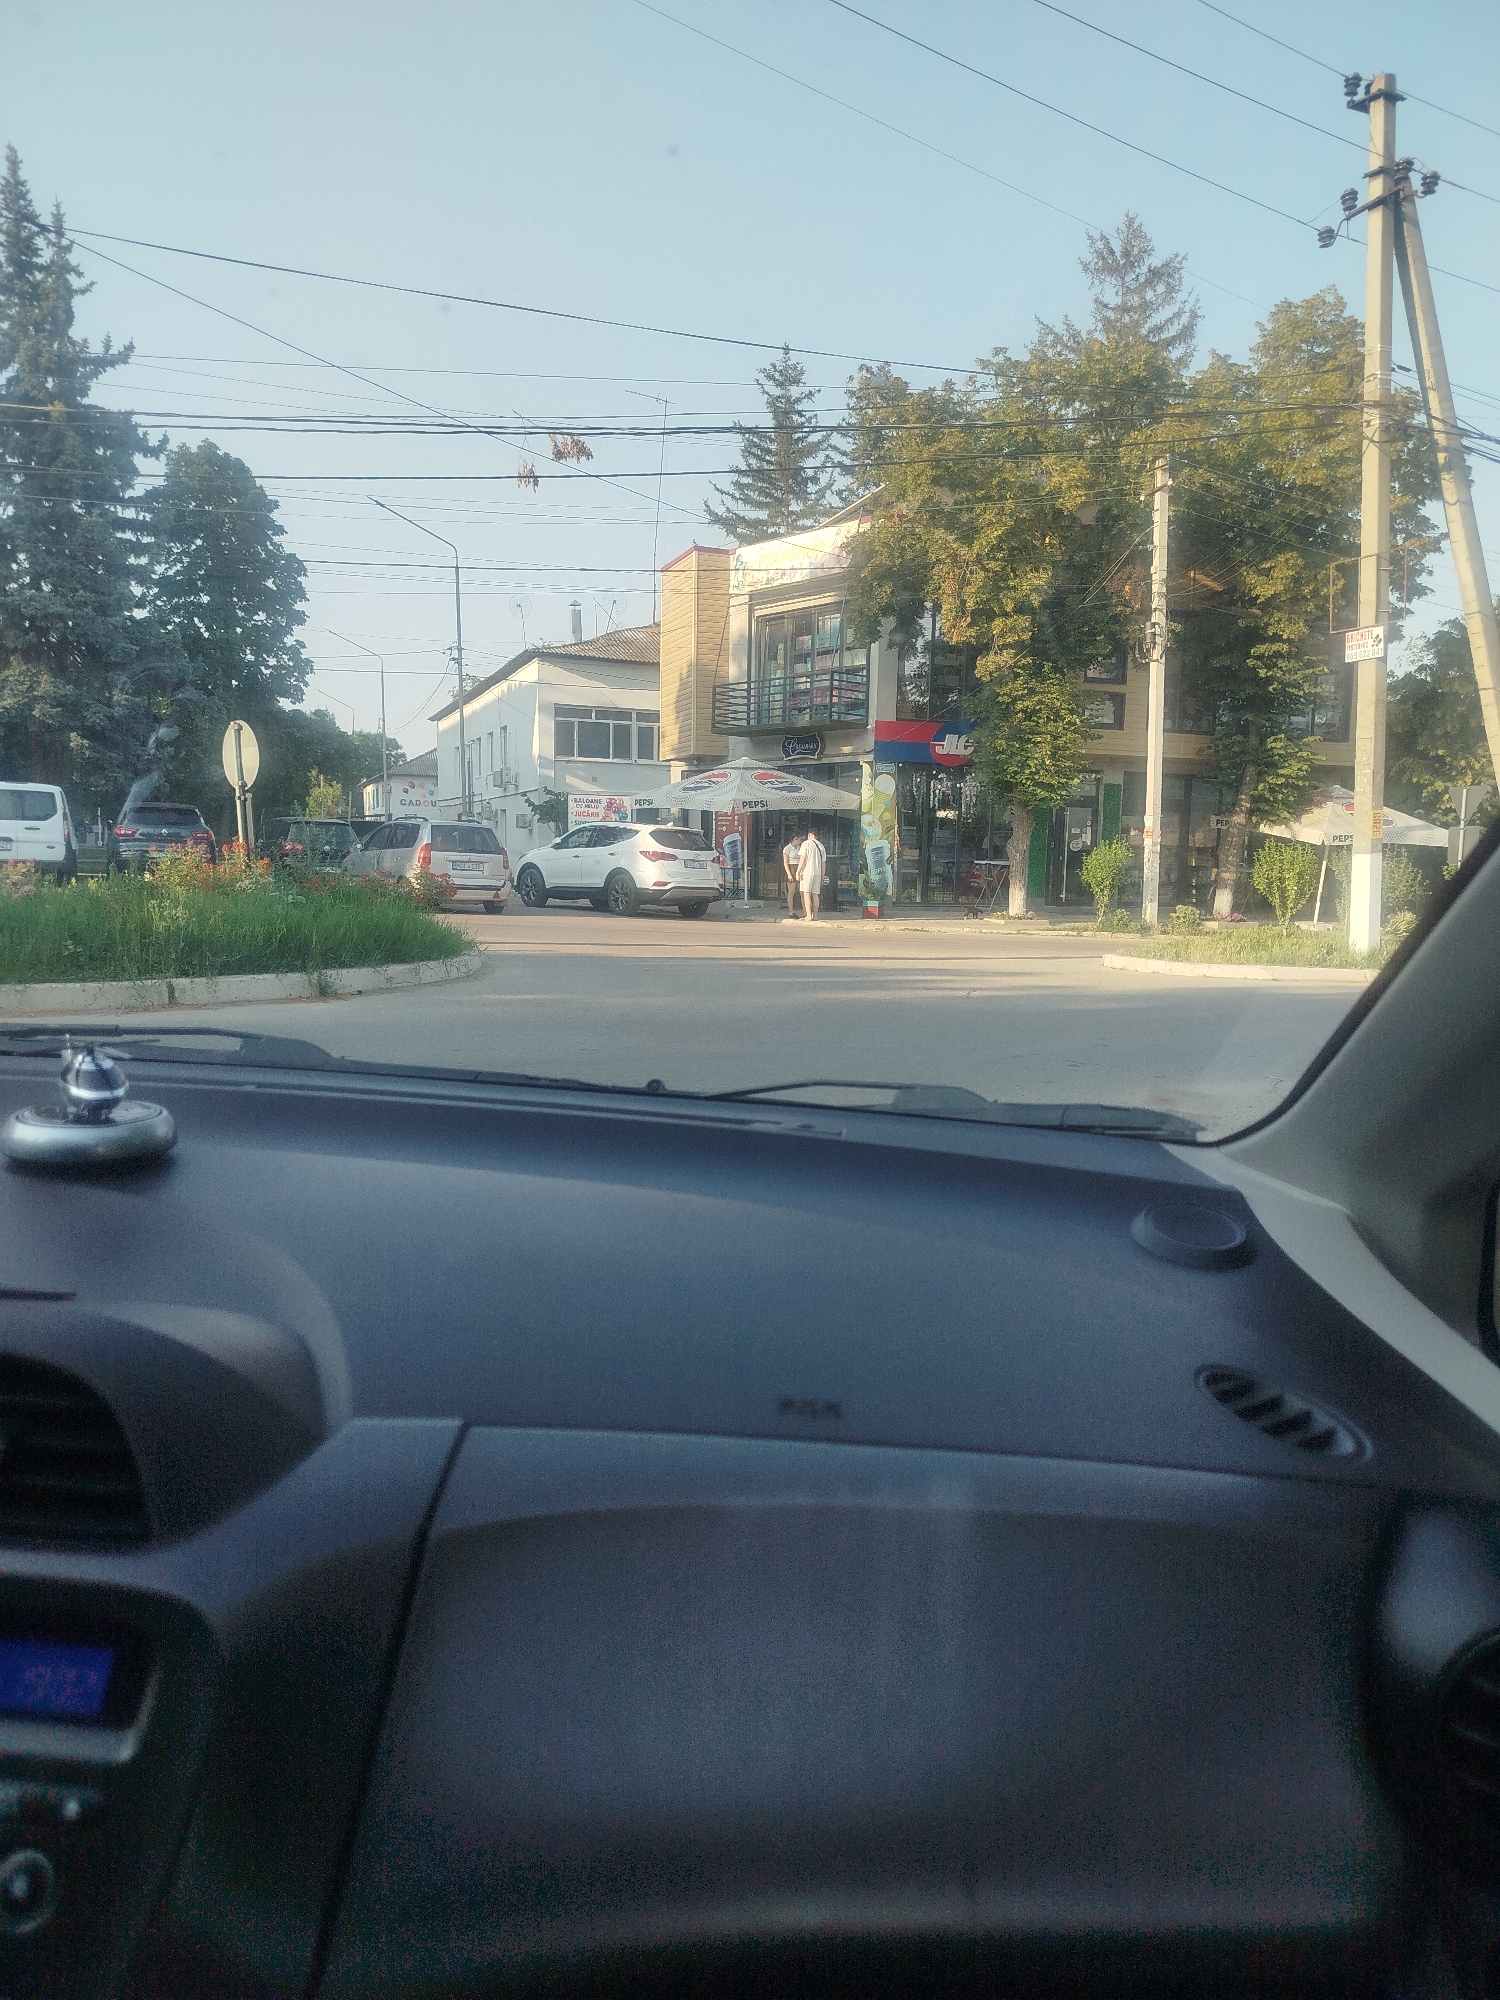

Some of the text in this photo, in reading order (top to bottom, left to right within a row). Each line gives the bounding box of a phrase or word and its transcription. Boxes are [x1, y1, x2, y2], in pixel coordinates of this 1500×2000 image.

[935, 734, 975, 755] JLC
[634, 799, 654, 807] PEPSI
[742, 800, 769, 809] PEPSI
[1215, 819, 1230, 827] PEP
[1332, 834, 1354, 843] PEPS
